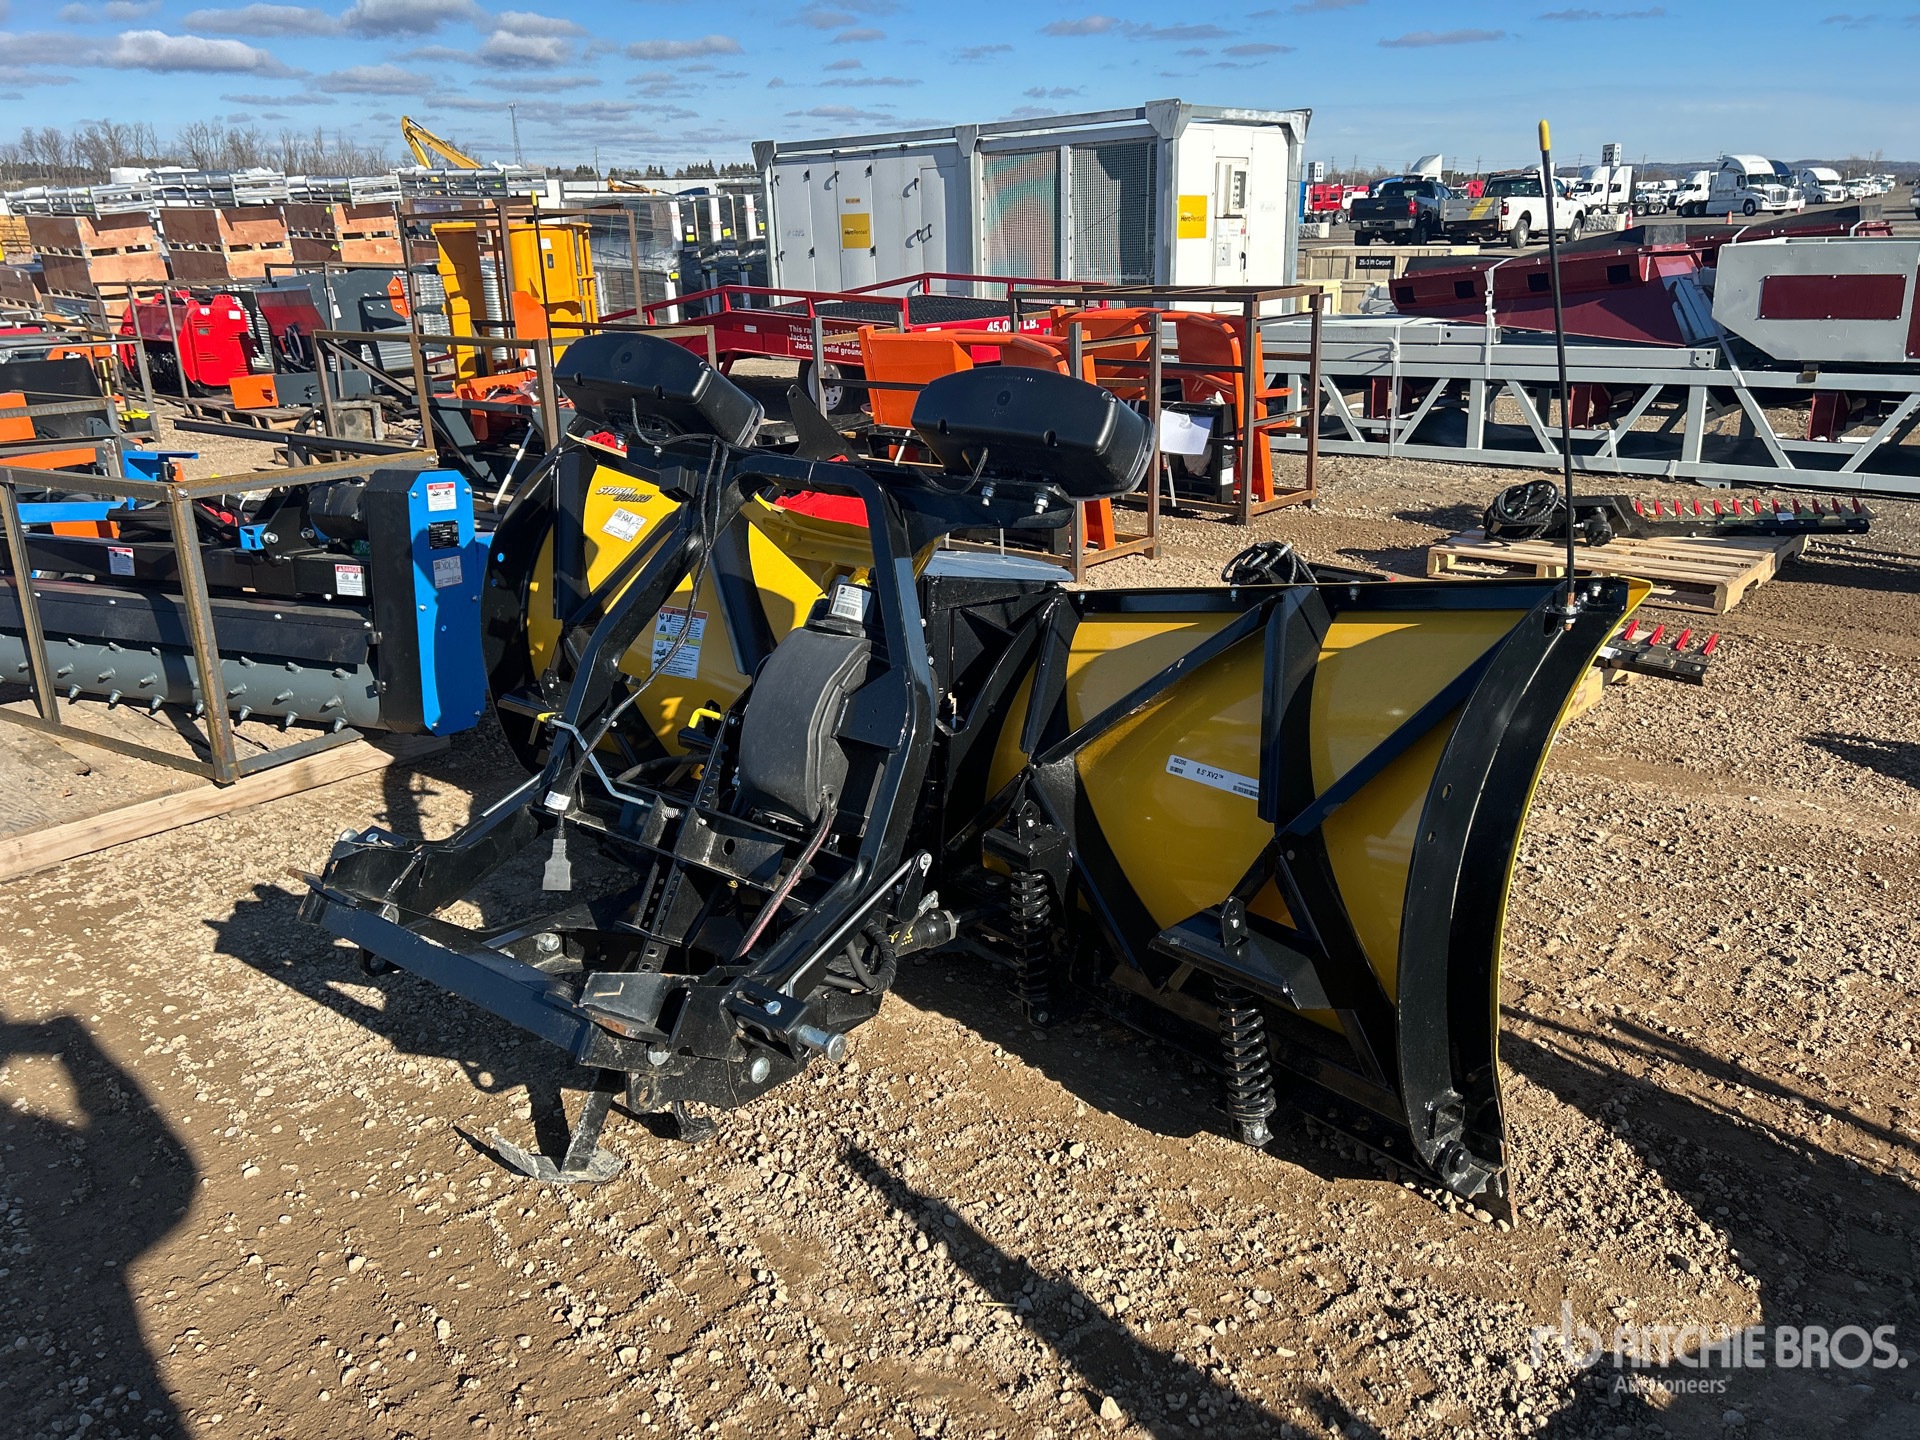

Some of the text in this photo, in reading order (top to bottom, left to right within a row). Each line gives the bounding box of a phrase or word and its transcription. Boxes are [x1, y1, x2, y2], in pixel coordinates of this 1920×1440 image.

[1603, 152, 1613, 162] 12
[1316, 169, 1322, 177] 11
[788, 324, 802, 333] This
[795, 342, 813, 350] Jacks
